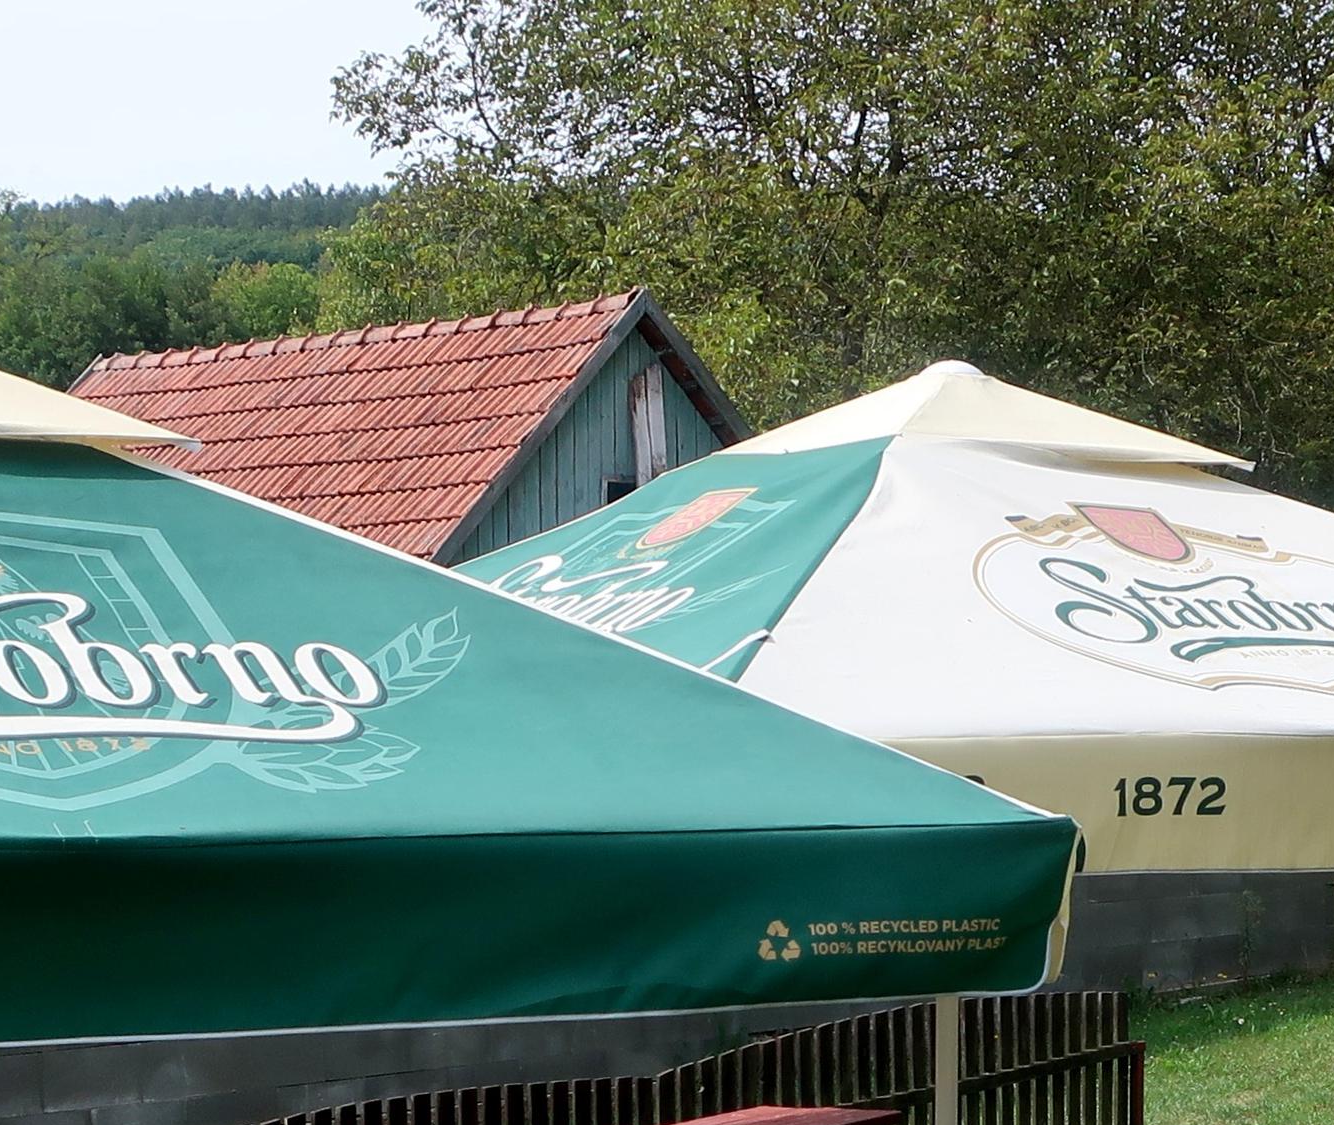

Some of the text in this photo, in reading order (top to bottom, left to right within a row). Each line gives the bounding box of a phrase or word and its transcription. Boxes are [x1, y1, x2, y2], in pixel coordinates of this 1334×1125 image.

[487, 553, 695, 633] obrno
[61, 736, 151, 753] 1872
[1113, 776, 1227, 817] 1872
[808, 917, 1001, 936] 100 % RECYCLED PLASTIC
[811, 935, 1008, 956] 100% RECYKLOVANÝ PLAST
